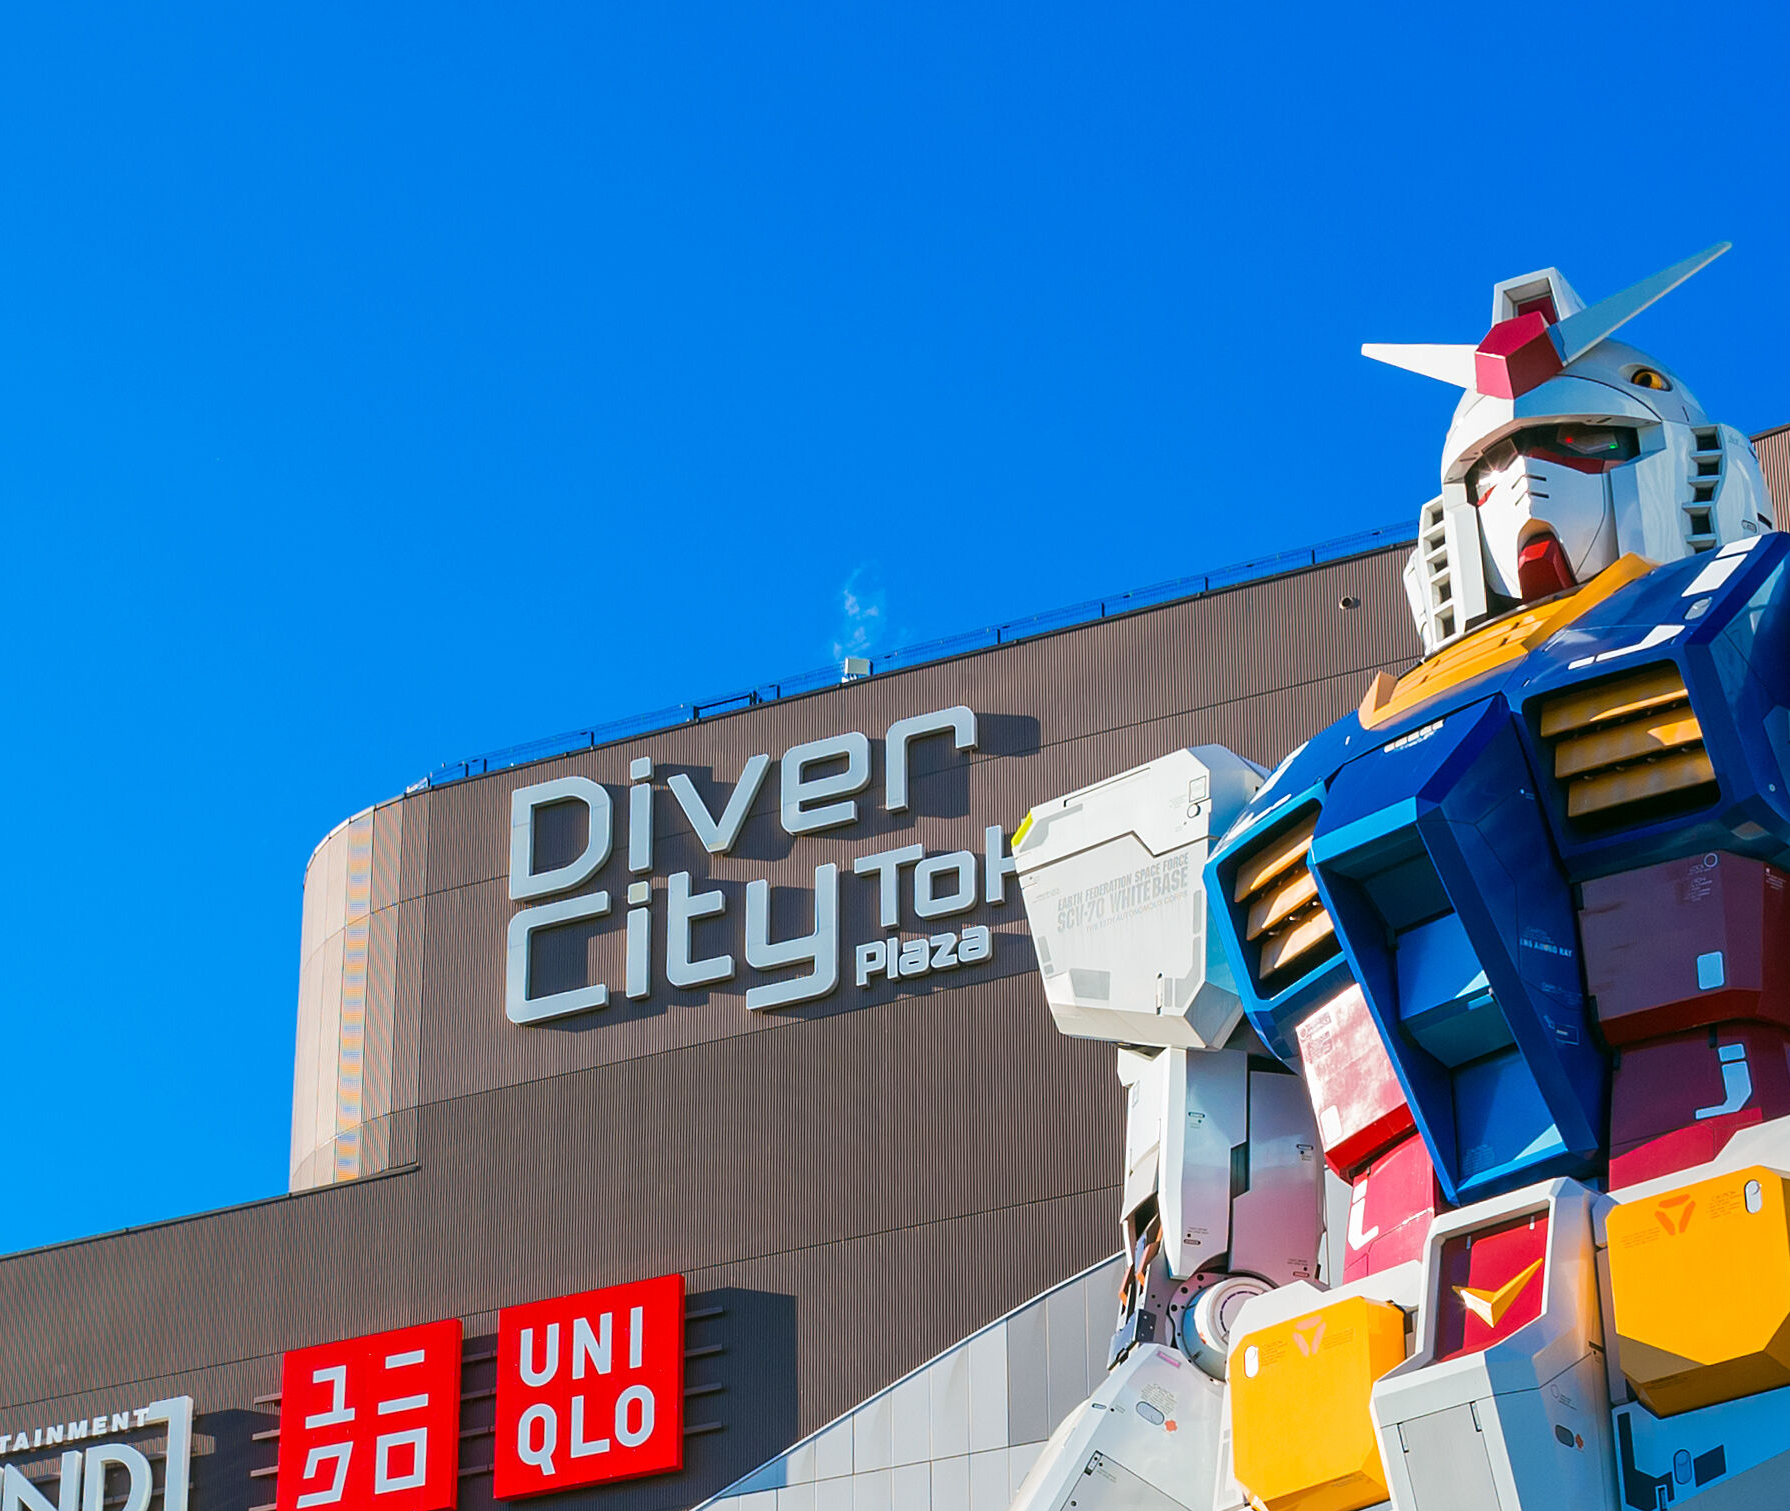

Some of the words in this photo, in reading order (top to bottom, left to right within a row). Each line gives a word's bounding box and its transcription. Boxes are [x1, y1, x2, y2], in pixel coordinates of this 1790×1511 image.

[509, 706, 978, 900] Diver
[1059, 892, 1083, 911] EARTH
[1085, 874, 1132, 900] FEDERATION
[1134, 862, 1161, 883] SPACE
[1163, 852, 1189, 873] FORCE
[1110, 879, 1151, 914] WHITE
[1152, 867, 1188, 897] BASE
[506, 862, 840, 1026] City
[855, 925, 993, 988] Plaza
[518, 1306, 645, 1387] UNI
[305, 1350, 429, 1429] ユニ
[516, 1385, 657, 1475] QLO
[296, 1427, 429, 1509] クロ
